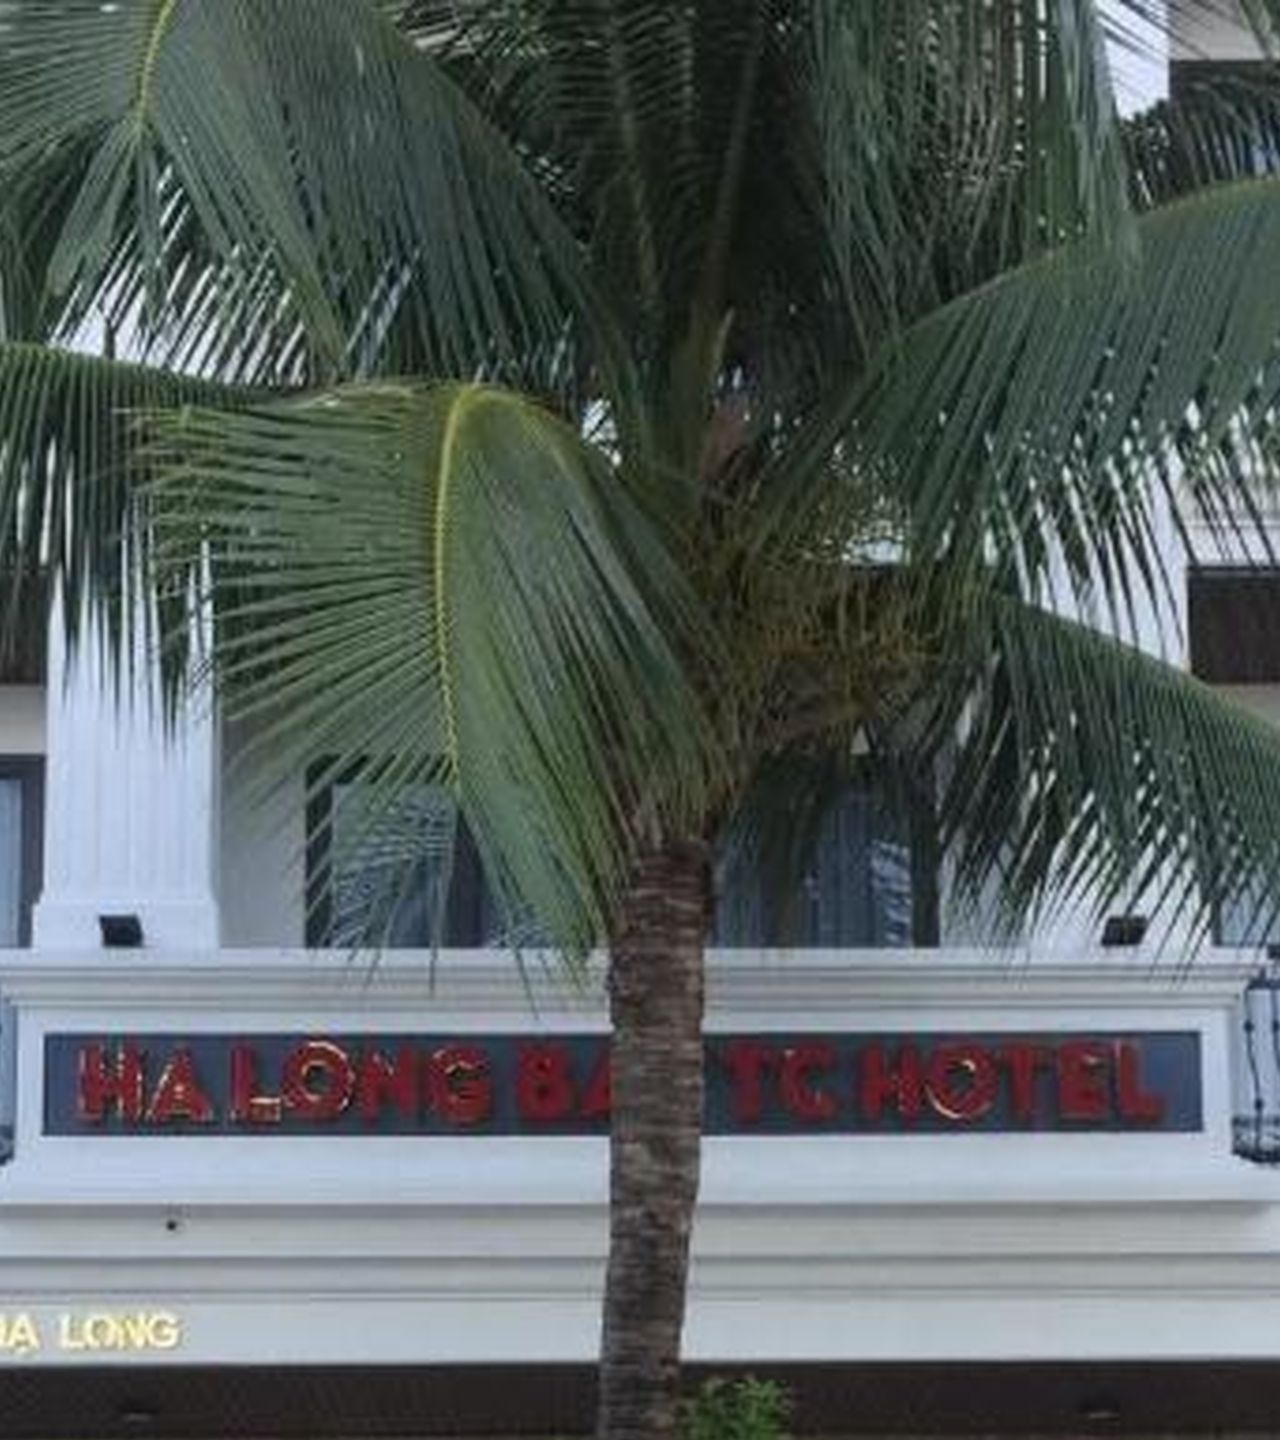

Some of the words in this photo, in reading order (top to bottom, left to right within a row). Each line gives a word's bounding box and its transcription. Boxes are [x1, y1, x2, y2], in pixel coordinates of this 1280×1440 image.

[78, 1043, 213, 1122] HA
[230, 1040, 492, 1124] LONG
[724, 1040, 838, 1121] TC
[859, 1040, 1166, 1122] HOTEL
[60, 1312, 180, 1350] LONG
